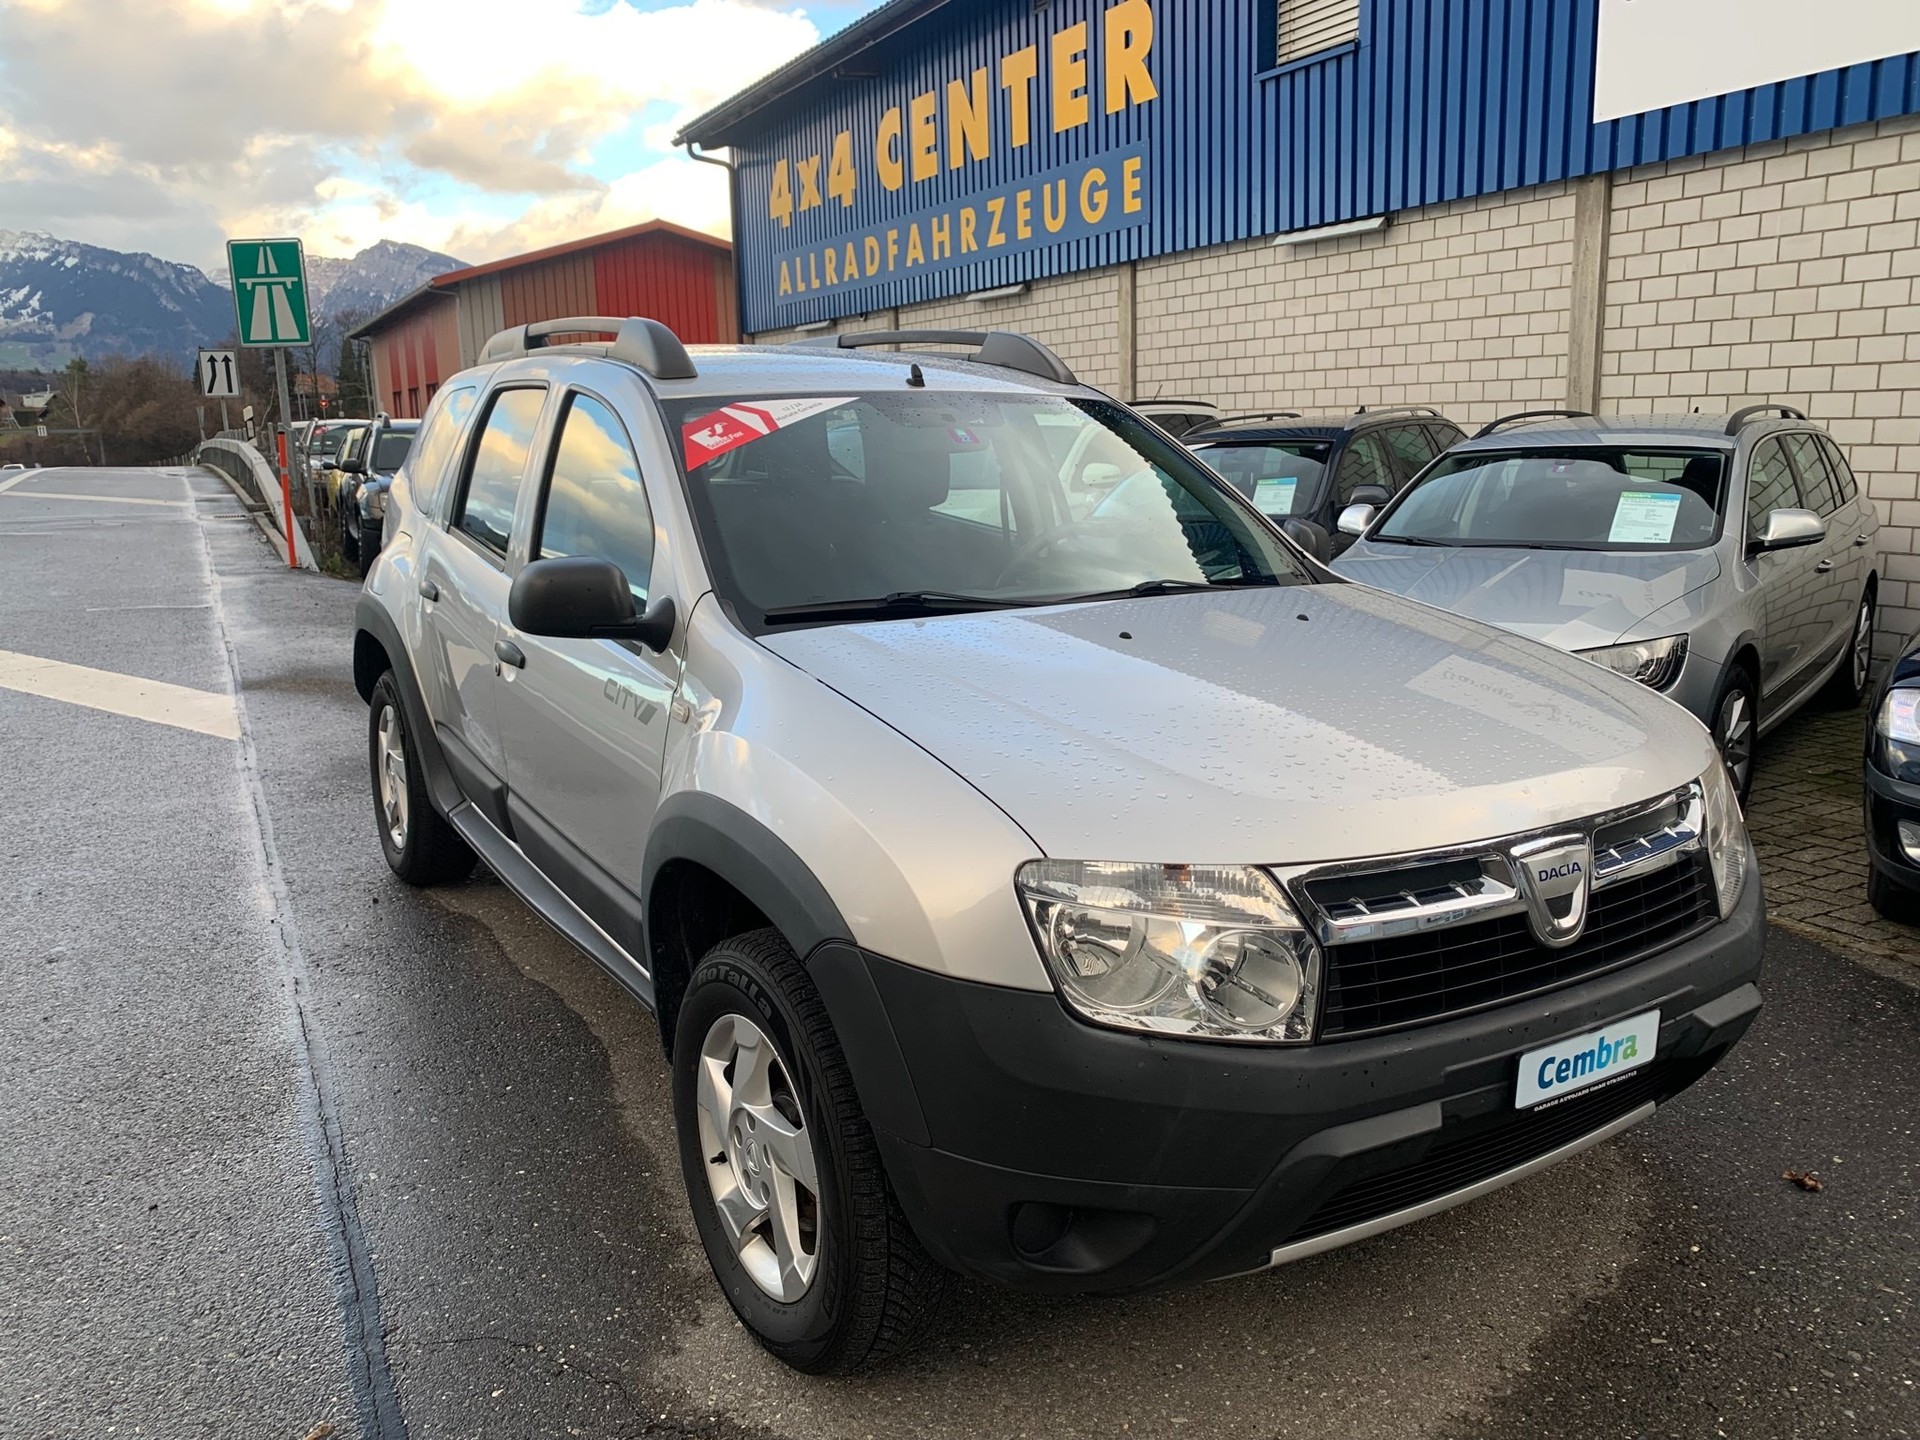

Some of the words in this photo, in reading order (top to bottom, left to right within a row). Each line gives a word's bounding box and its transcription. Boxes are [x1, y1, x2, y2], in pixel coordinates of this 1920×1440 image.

[770, 130, 857, 228] 4x4
[876, 0, 1159, 191] CENTER
[778, 156, 1142, 297] ALLRADFAHRZEUGE
[604, 677, 645, 718] CITY
[1538, 861, 1582, 882] DACIA
[1538, 1034, 1638, 1090] Cembra
